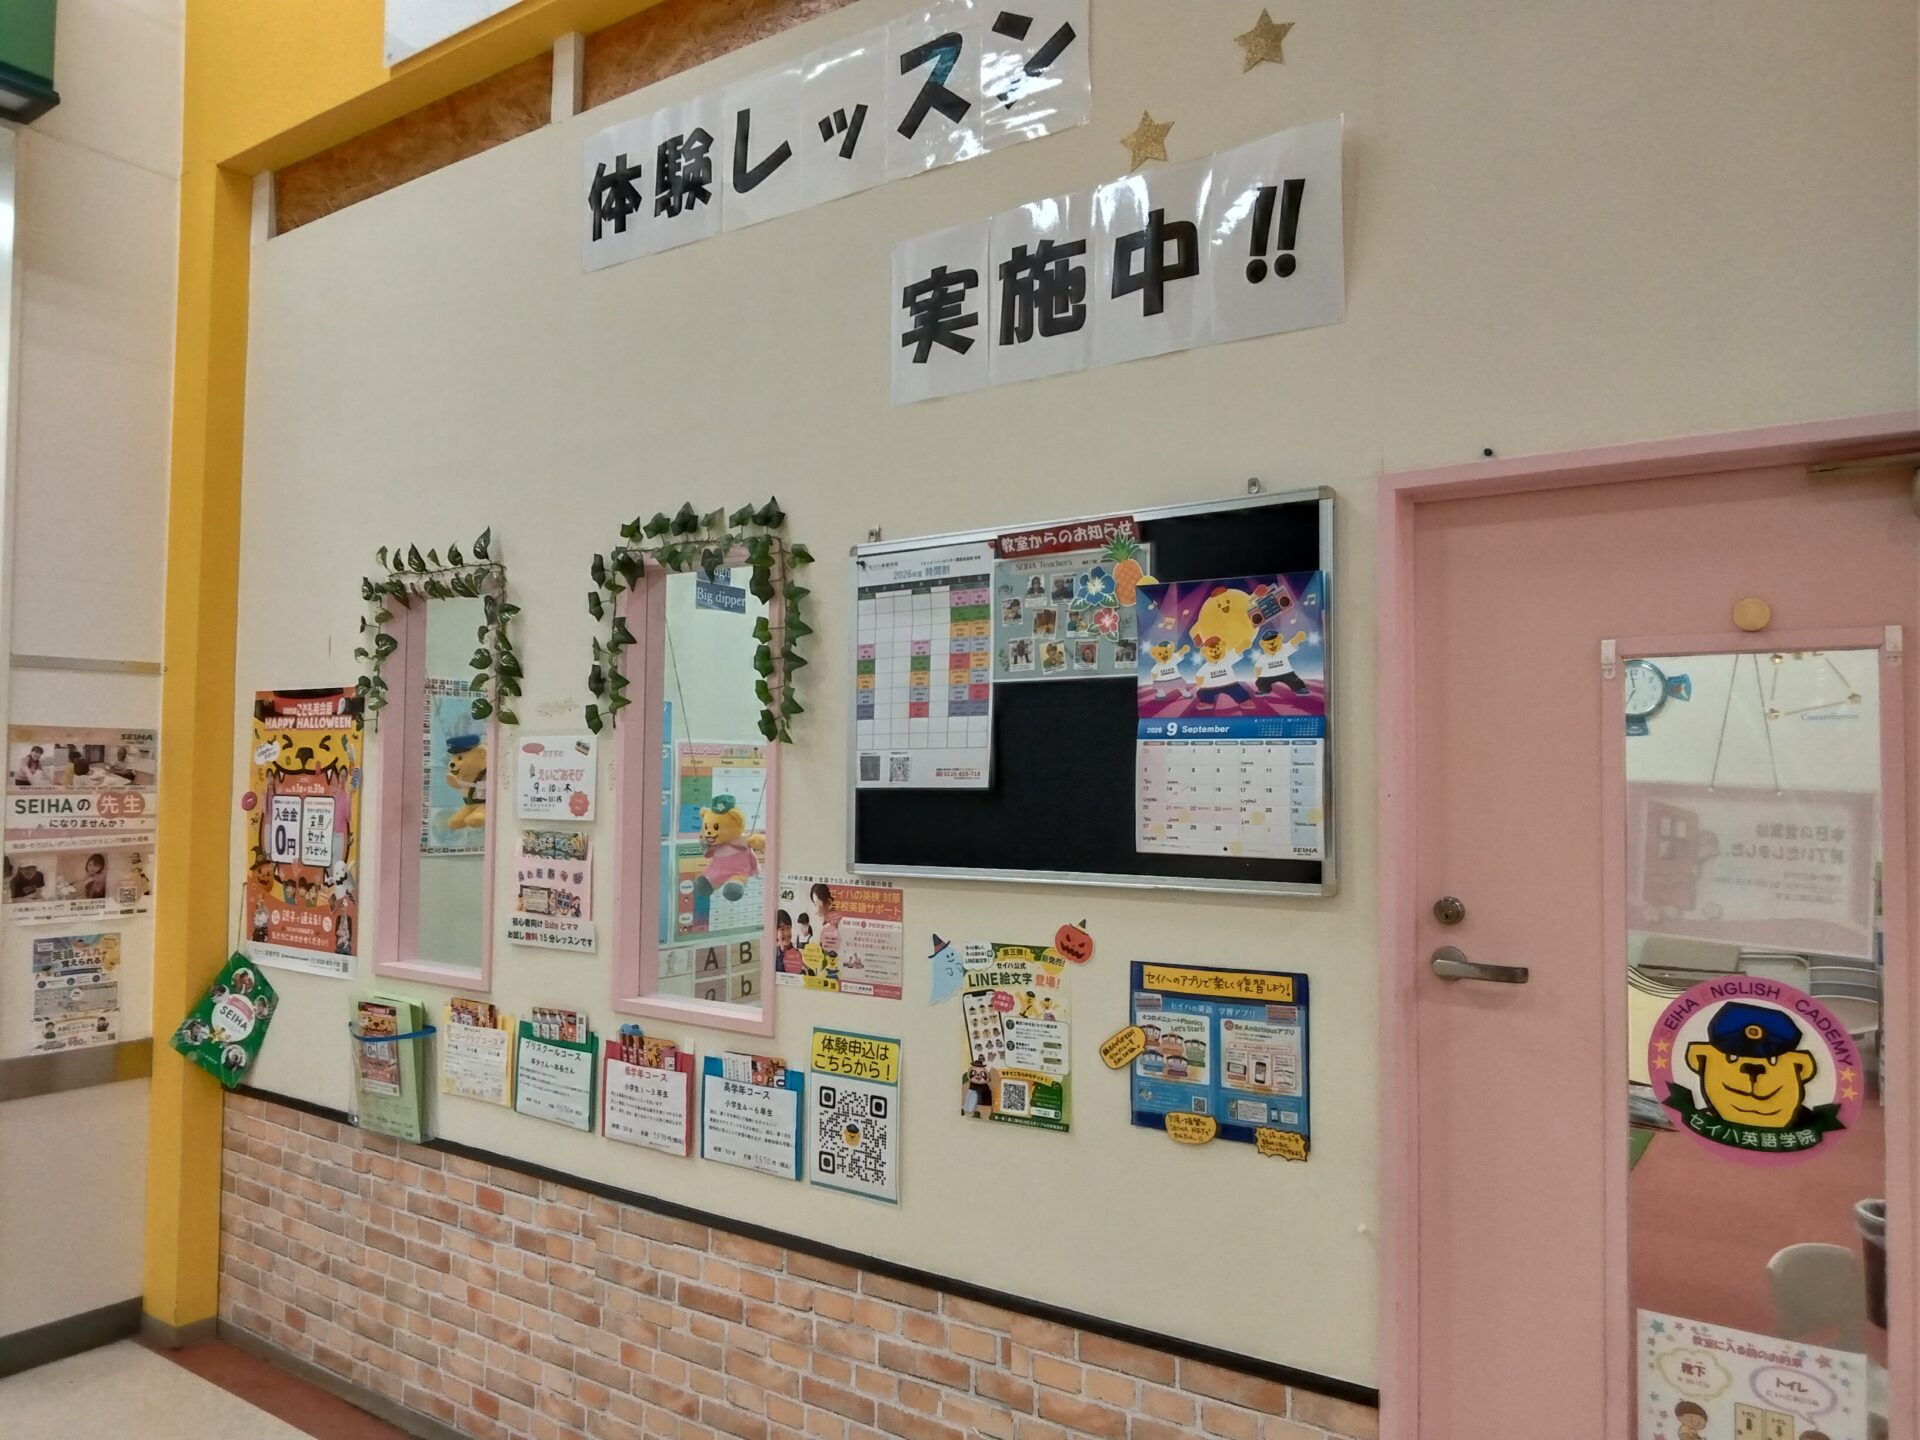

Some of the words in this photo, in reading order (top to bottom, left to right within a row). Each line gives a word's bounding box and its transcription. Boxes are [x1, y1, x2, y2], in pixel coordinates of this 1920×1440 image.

[587, 10, 1076, 242] 体験レッスン
[1000, 520, 1134, 554] 教室からのお知らせ
[697, 587, 713, 604] Big
[715, 590, 746, 608] dipper
[264, 716, 296, 729] HAPPY
[296, 716, 352, 729] HALLOWEEN
[1146, 726, 1163, 734] 2026
[1166, 721, 1178, 736] 9
[1181, 725, 1230, 735] September
[121, 733, 153, 741] SEIHA
[538, 768, 585, 782] えいごあそび
[274, 807, 298, 822] 入会金
[310, 814, 325, 828] 文具
[49, 819, 126, 828] になりませんか?
[275, 824, 297, 856] 0円
[307, 830, 325, 842] セット
[305, 846, 328, 857] プレゼント
[512, 917, 543, 928] 初心者向け
[544, 920, 559, 930] Baby
[560, 922, 579, 931] とママ
[704, 946, 719, 971] A
[739, 941, 753, 964] B
[996, 962, 1027, 970] セイハ公式
[741, 975, 752, 997] b
[968, 971, 1033, 987] LINE絵文字
[1145, 972, 1291, 996] セイハのアプリで楽しく復習しよう!
[219, 1005, 249, 1032] SEIHA
[821, 1034, 890, 1061] 体験申込は
[815, 1053, 890, 1081] こちらから!
[723, 1081, 771, 1100] 高学年コース
[1689, 1113, 1817, 1148] セイハ英語学院
[1775, 1376, 1809, 1393] トイレ
